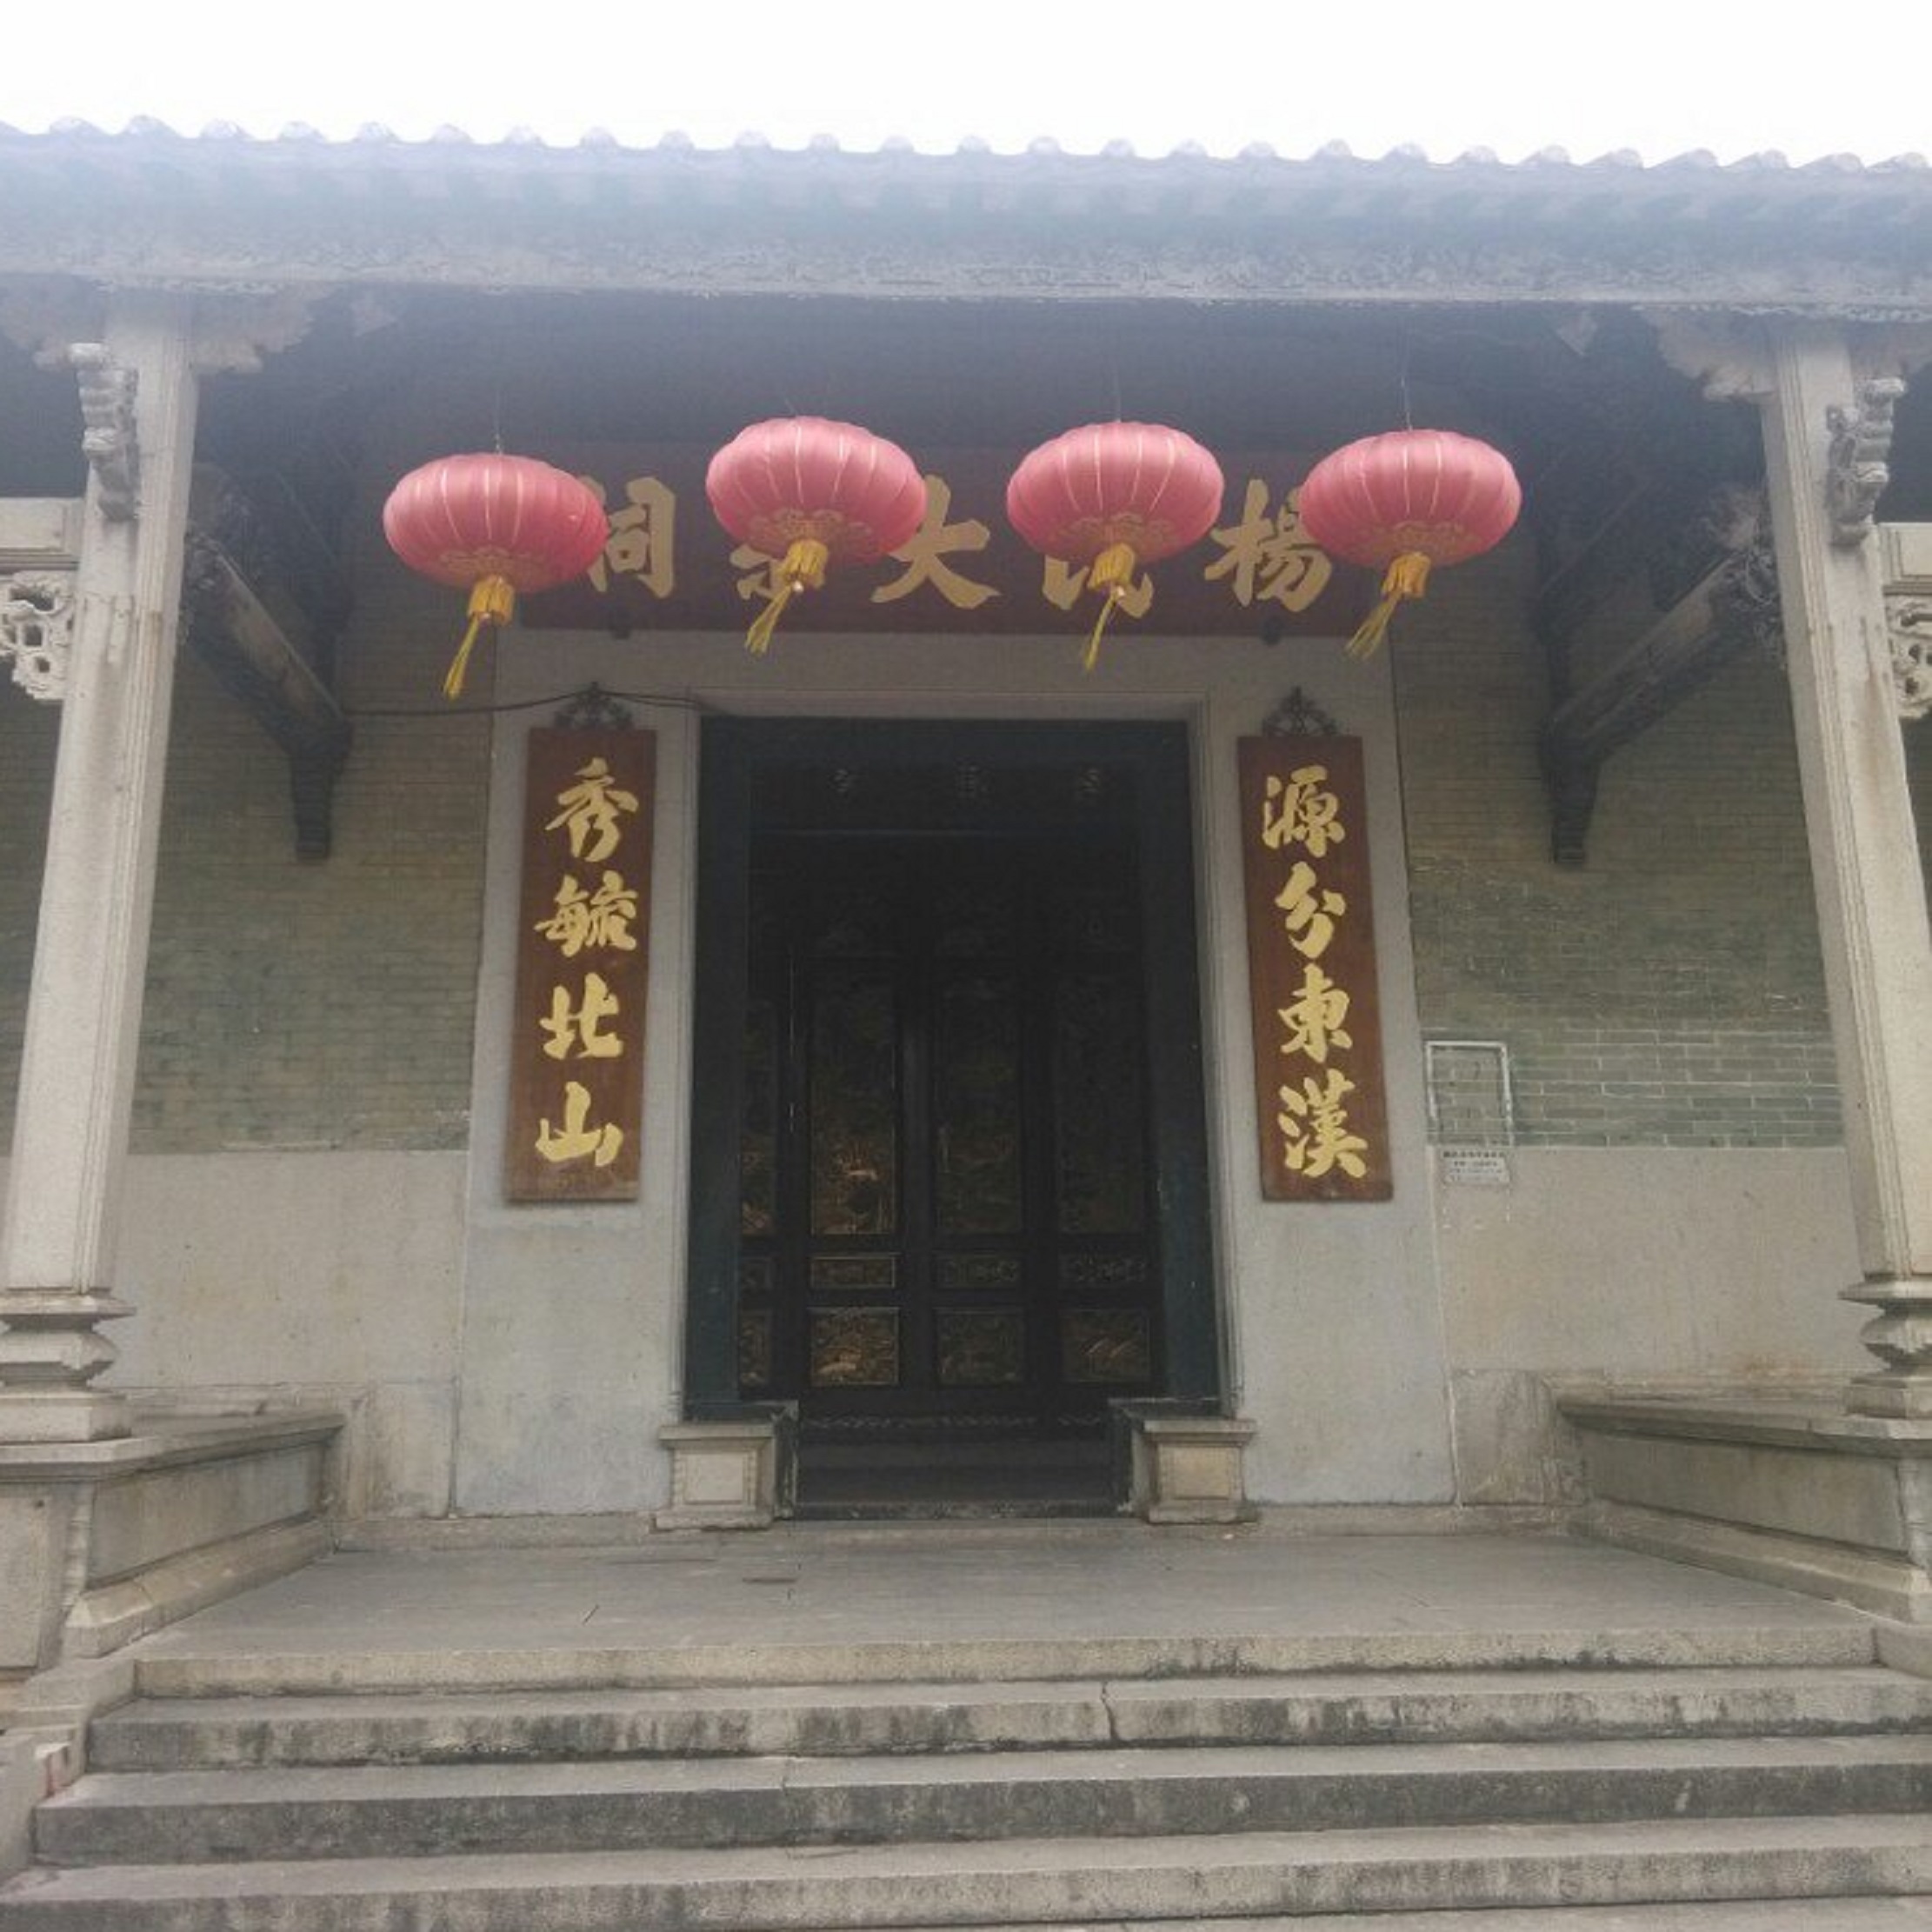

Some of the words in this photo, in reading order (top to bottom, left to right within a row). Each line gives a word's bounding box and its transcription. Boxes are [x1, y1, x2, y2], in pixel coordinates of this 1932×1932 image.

[577, 475, 1333, 616] 楊大祠
[534, 756, 640, 1168] 秀毓北山
[1262, 764, 1369, 1179] 源分東漢
